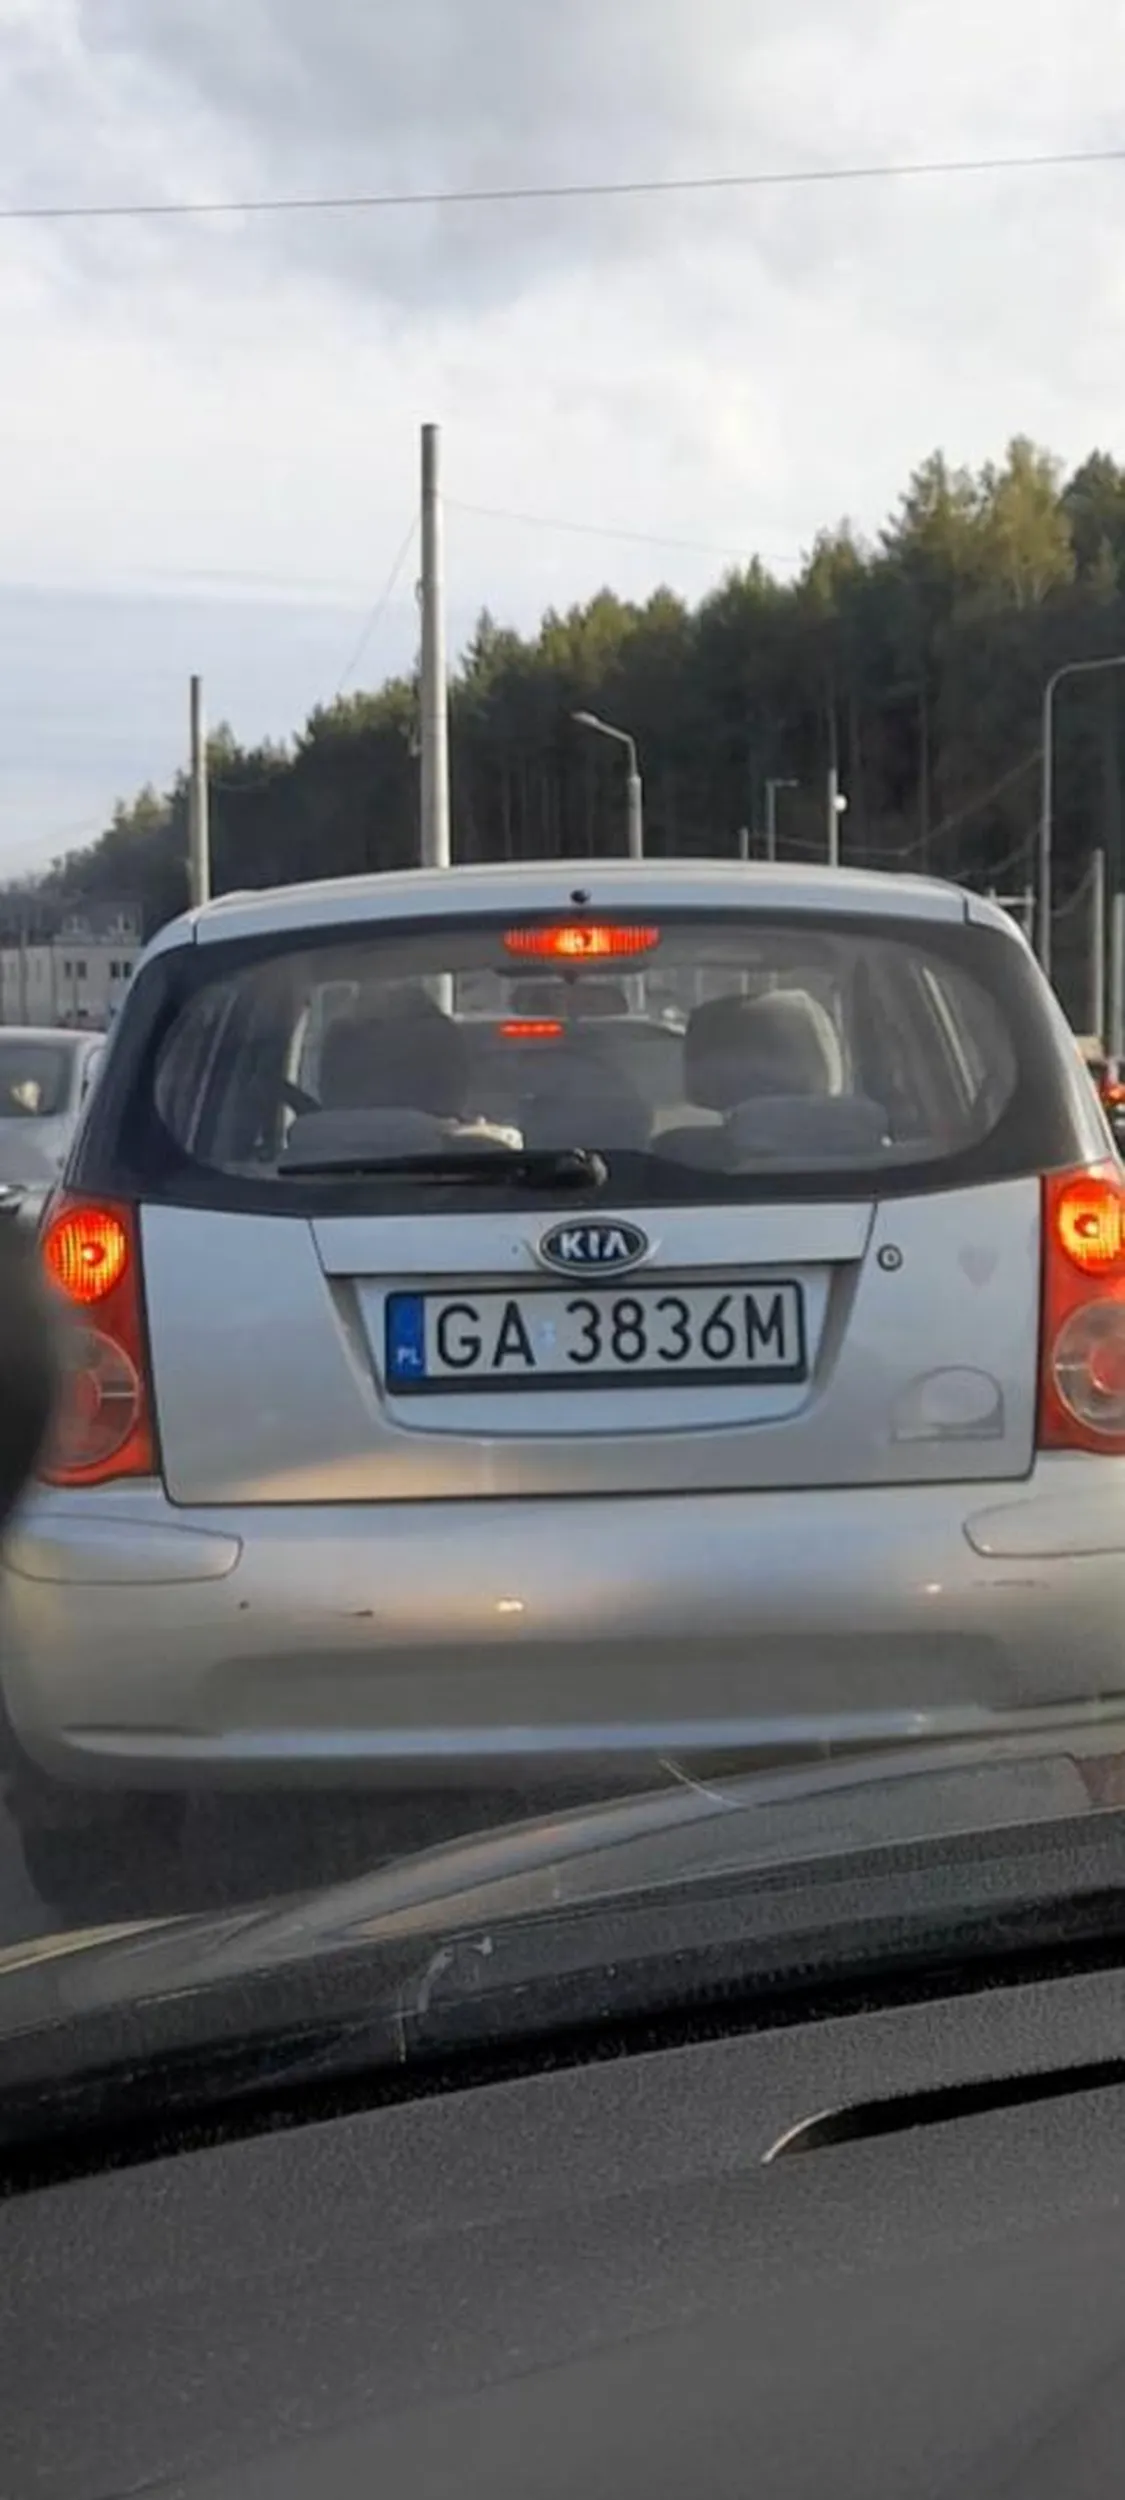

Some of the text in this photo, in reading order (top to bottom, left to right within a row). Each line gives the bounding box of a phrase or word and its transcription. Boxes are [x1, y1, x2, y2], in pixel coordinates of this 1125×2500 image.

[559, 1229, 629, 1260] KIA
[436, 1293, 786, 1369] GA 3836M
[397, 1347, 421, 1366] PL
